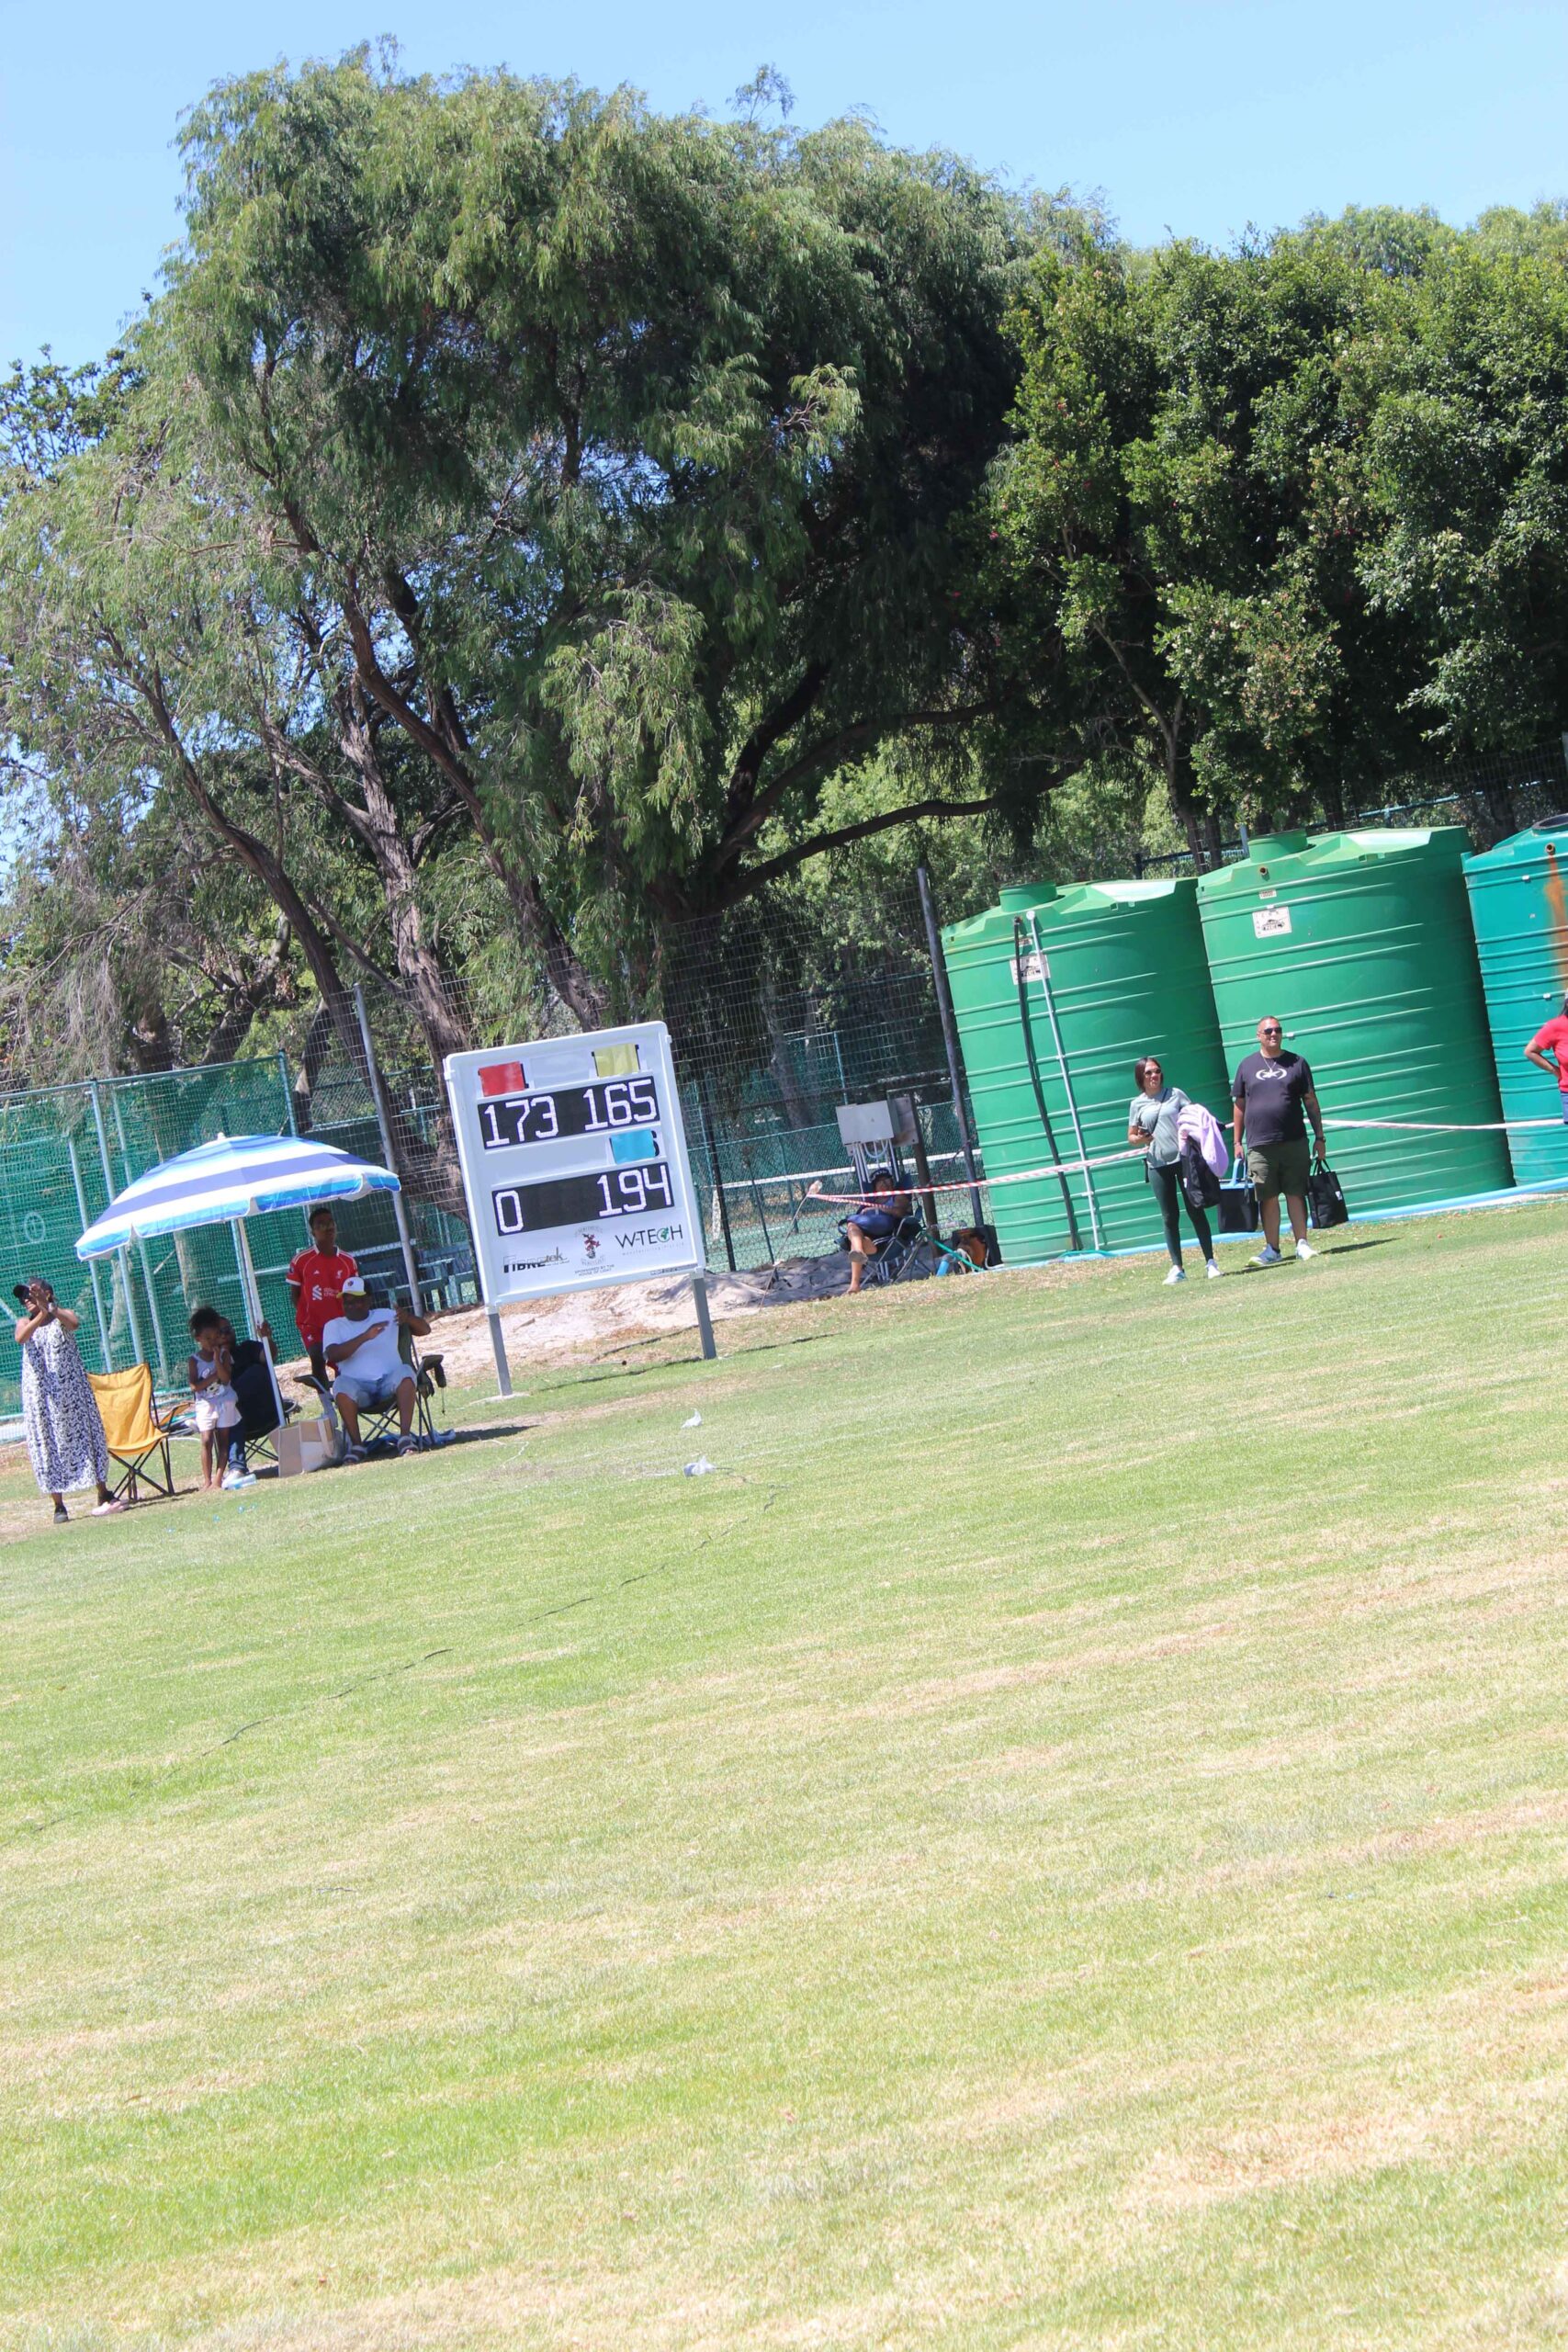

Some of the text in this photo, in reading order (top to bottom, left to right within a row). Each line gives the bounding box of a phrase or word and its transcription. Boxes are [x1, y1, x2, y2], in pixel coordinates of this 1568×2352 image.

[484, 1080, 657, 1148] 173 165
[495, 1165, 671, 1233] 0 194
[615, 1224, 683, 1249] W-TECH
